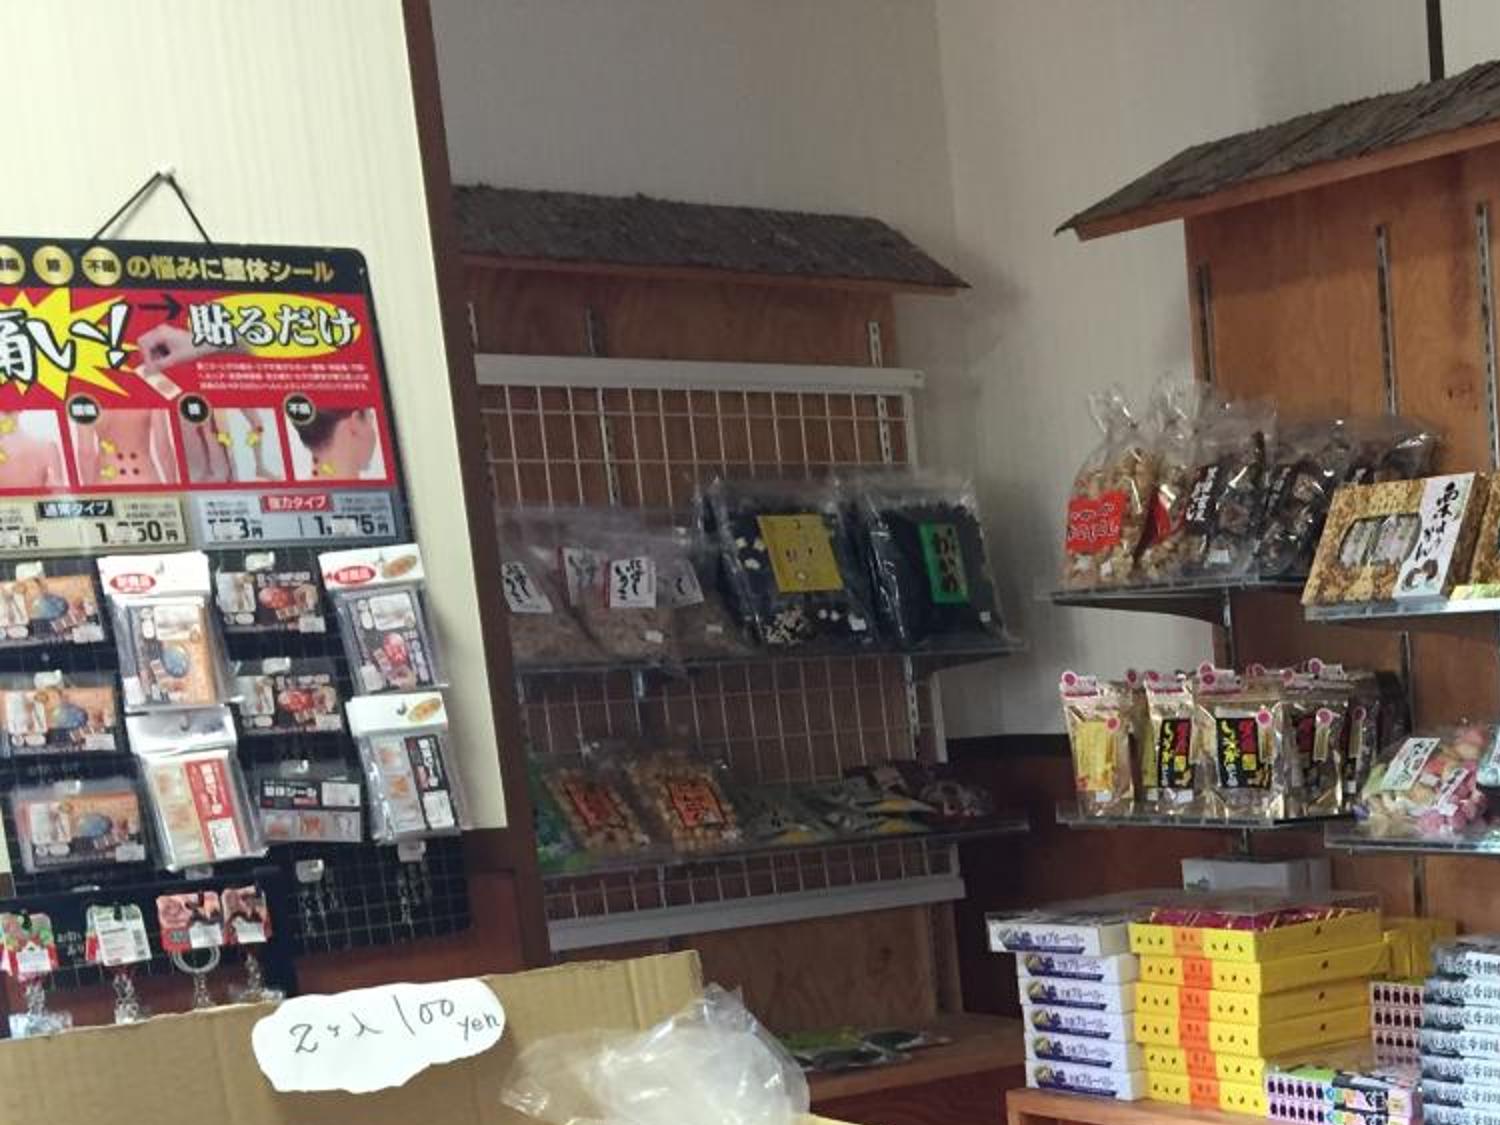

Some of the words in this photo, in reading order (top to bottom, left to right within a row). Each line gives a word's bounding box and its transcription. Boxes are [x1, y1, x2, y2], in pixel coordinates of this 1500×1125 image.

[189, 305, 356, 348] 貼るだけ
[396, 998, 456, 1038] 100
[457, 1010, 503, 1042] yen
